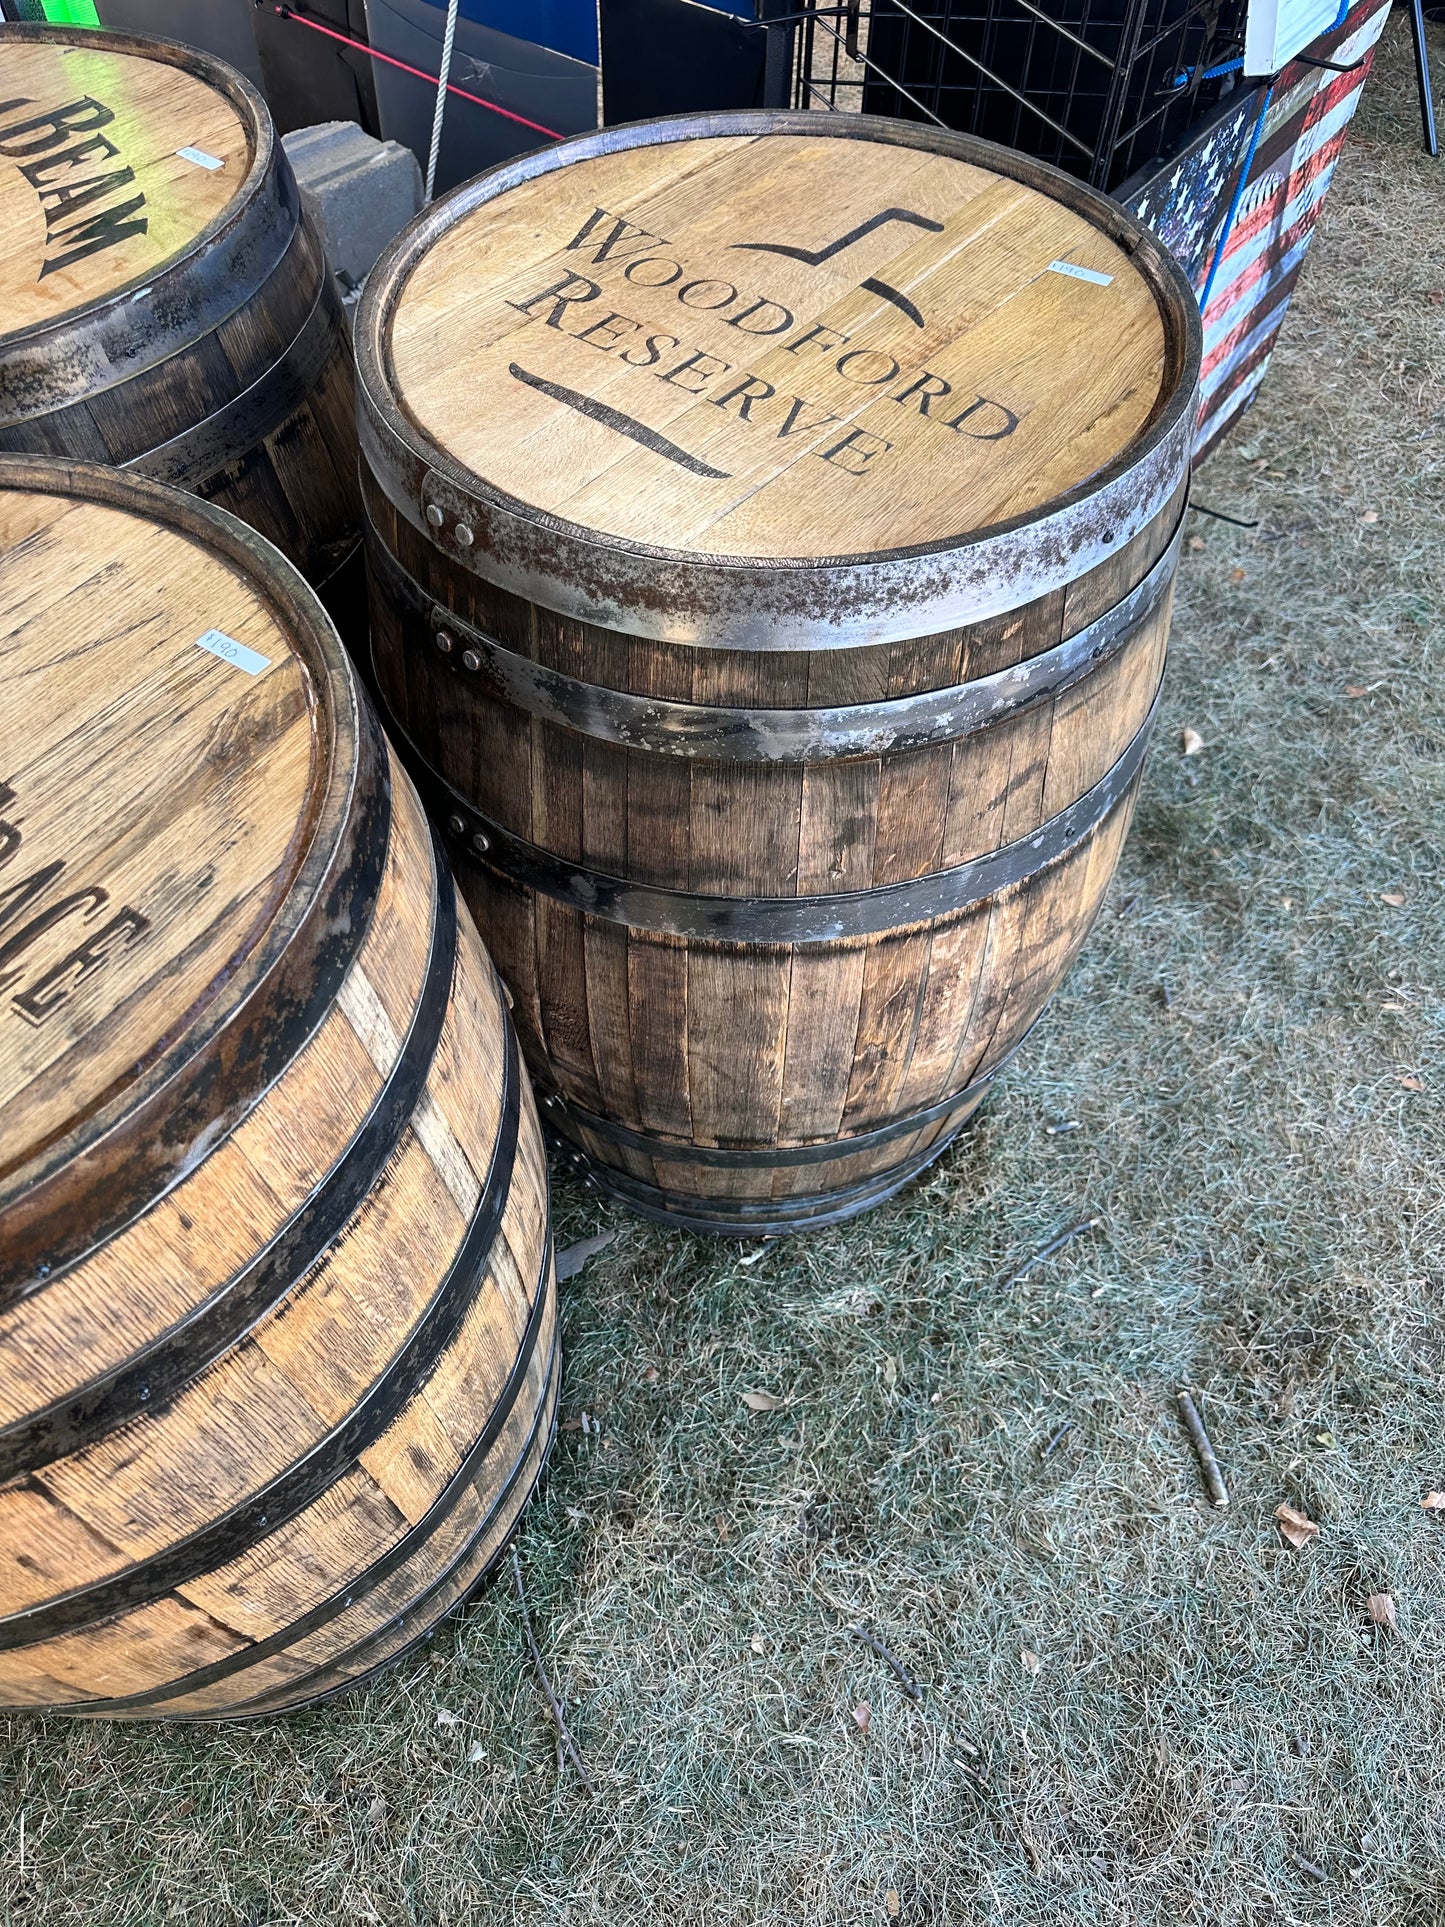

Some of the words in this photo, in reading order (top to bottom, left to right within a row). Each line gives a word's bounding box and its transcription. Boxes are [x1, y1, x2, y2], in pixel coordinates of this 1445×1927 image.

[0, 95, 148, 283] BEAM
[504, 268, 894, 476] RESERVE
[565, 206, 1020, 441] WOODFORD
[206, 633, 238, 658] $190
